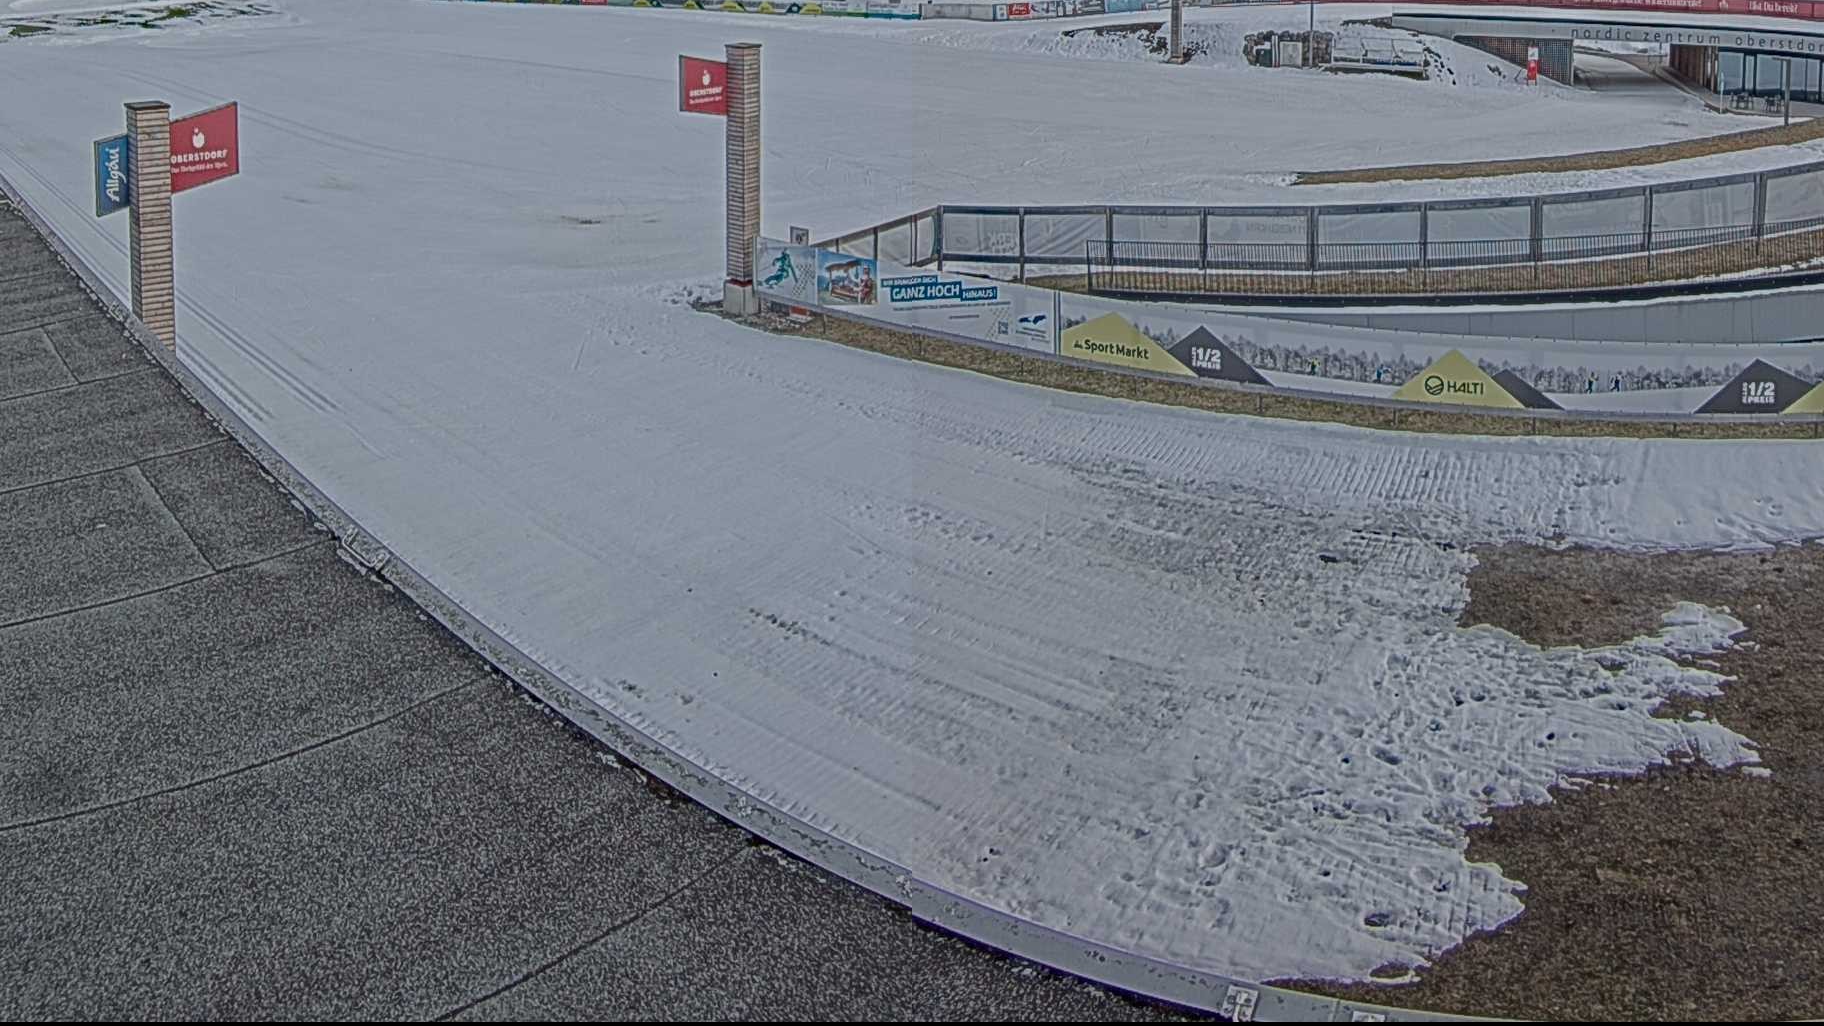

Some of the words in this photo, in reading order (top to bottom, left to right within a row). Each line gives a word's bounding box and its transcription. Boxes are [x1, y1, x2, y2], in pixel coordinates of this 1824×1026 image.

[1571, 27, 1632, 40] nordic
[1643, 31, 1721, 44] zentrum
[170, 149, 228, 164] OBERSTDORF
[927, 283, 960, 298] HOCH
[1447, 380, 1484, 395] HALTI
